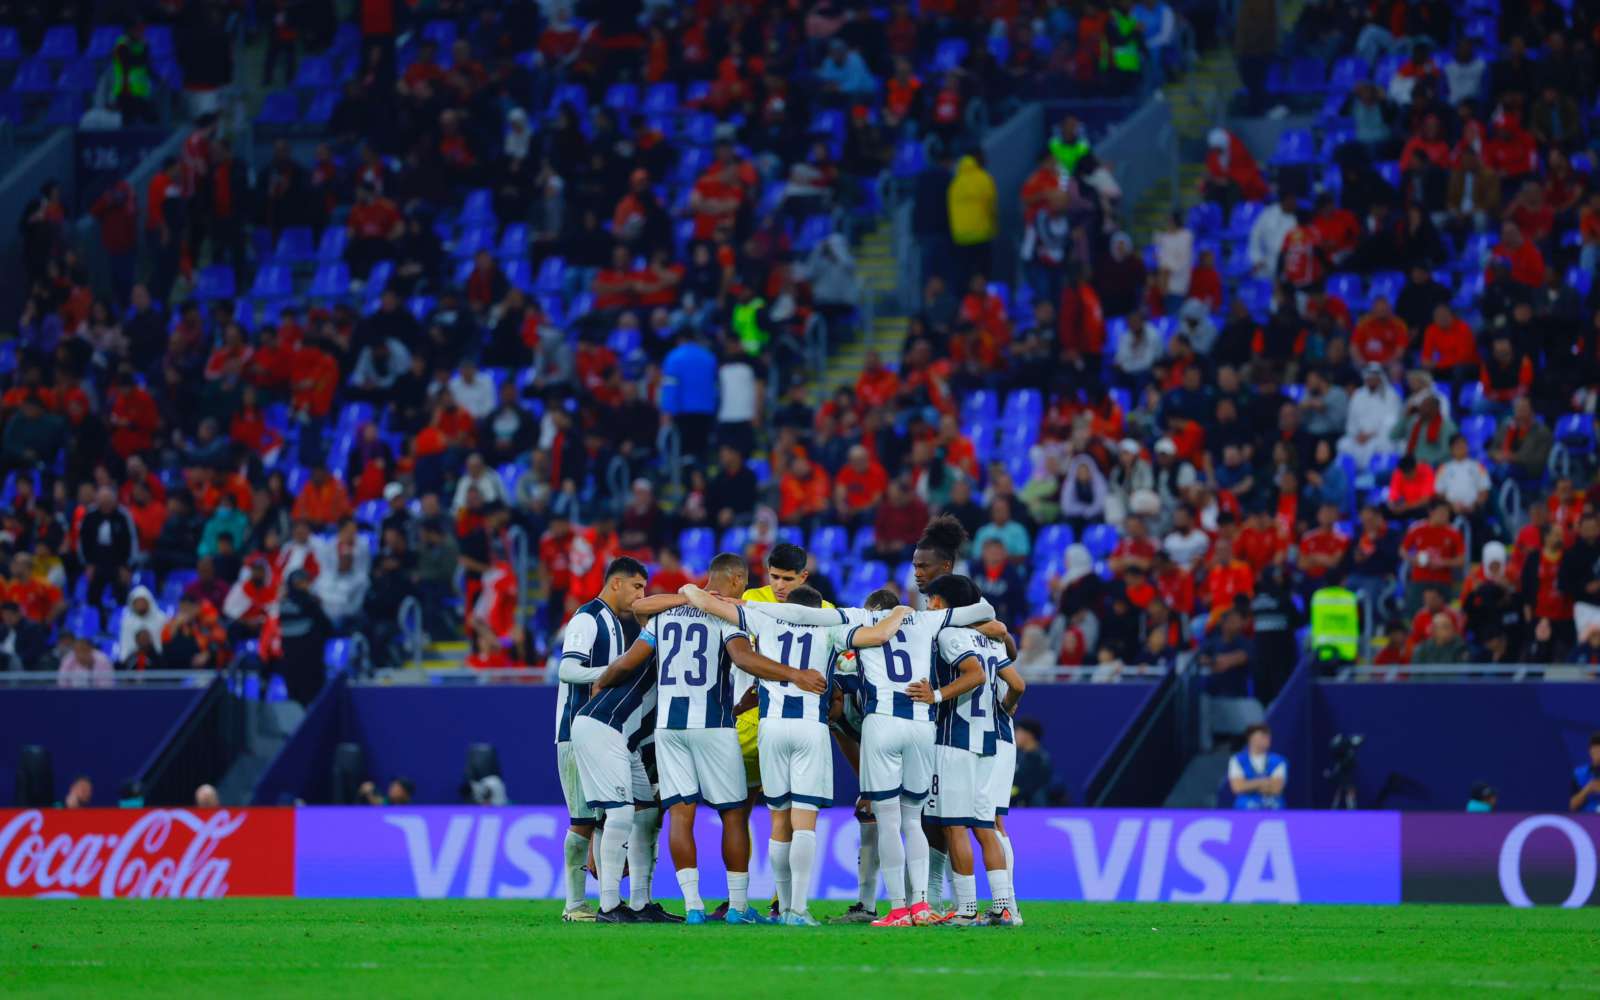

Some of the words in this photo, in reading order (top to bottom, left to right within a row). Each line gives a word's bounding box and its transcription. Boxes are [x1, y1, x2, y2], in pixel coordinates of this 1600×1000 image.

[660, 621, 708, 687] 23
[777, 629, 813, 687] 11
[882, 630, 913, 683] 6
[384, 814, 602, 899] VIS
[1046, 817, 1301, 903] VISA
